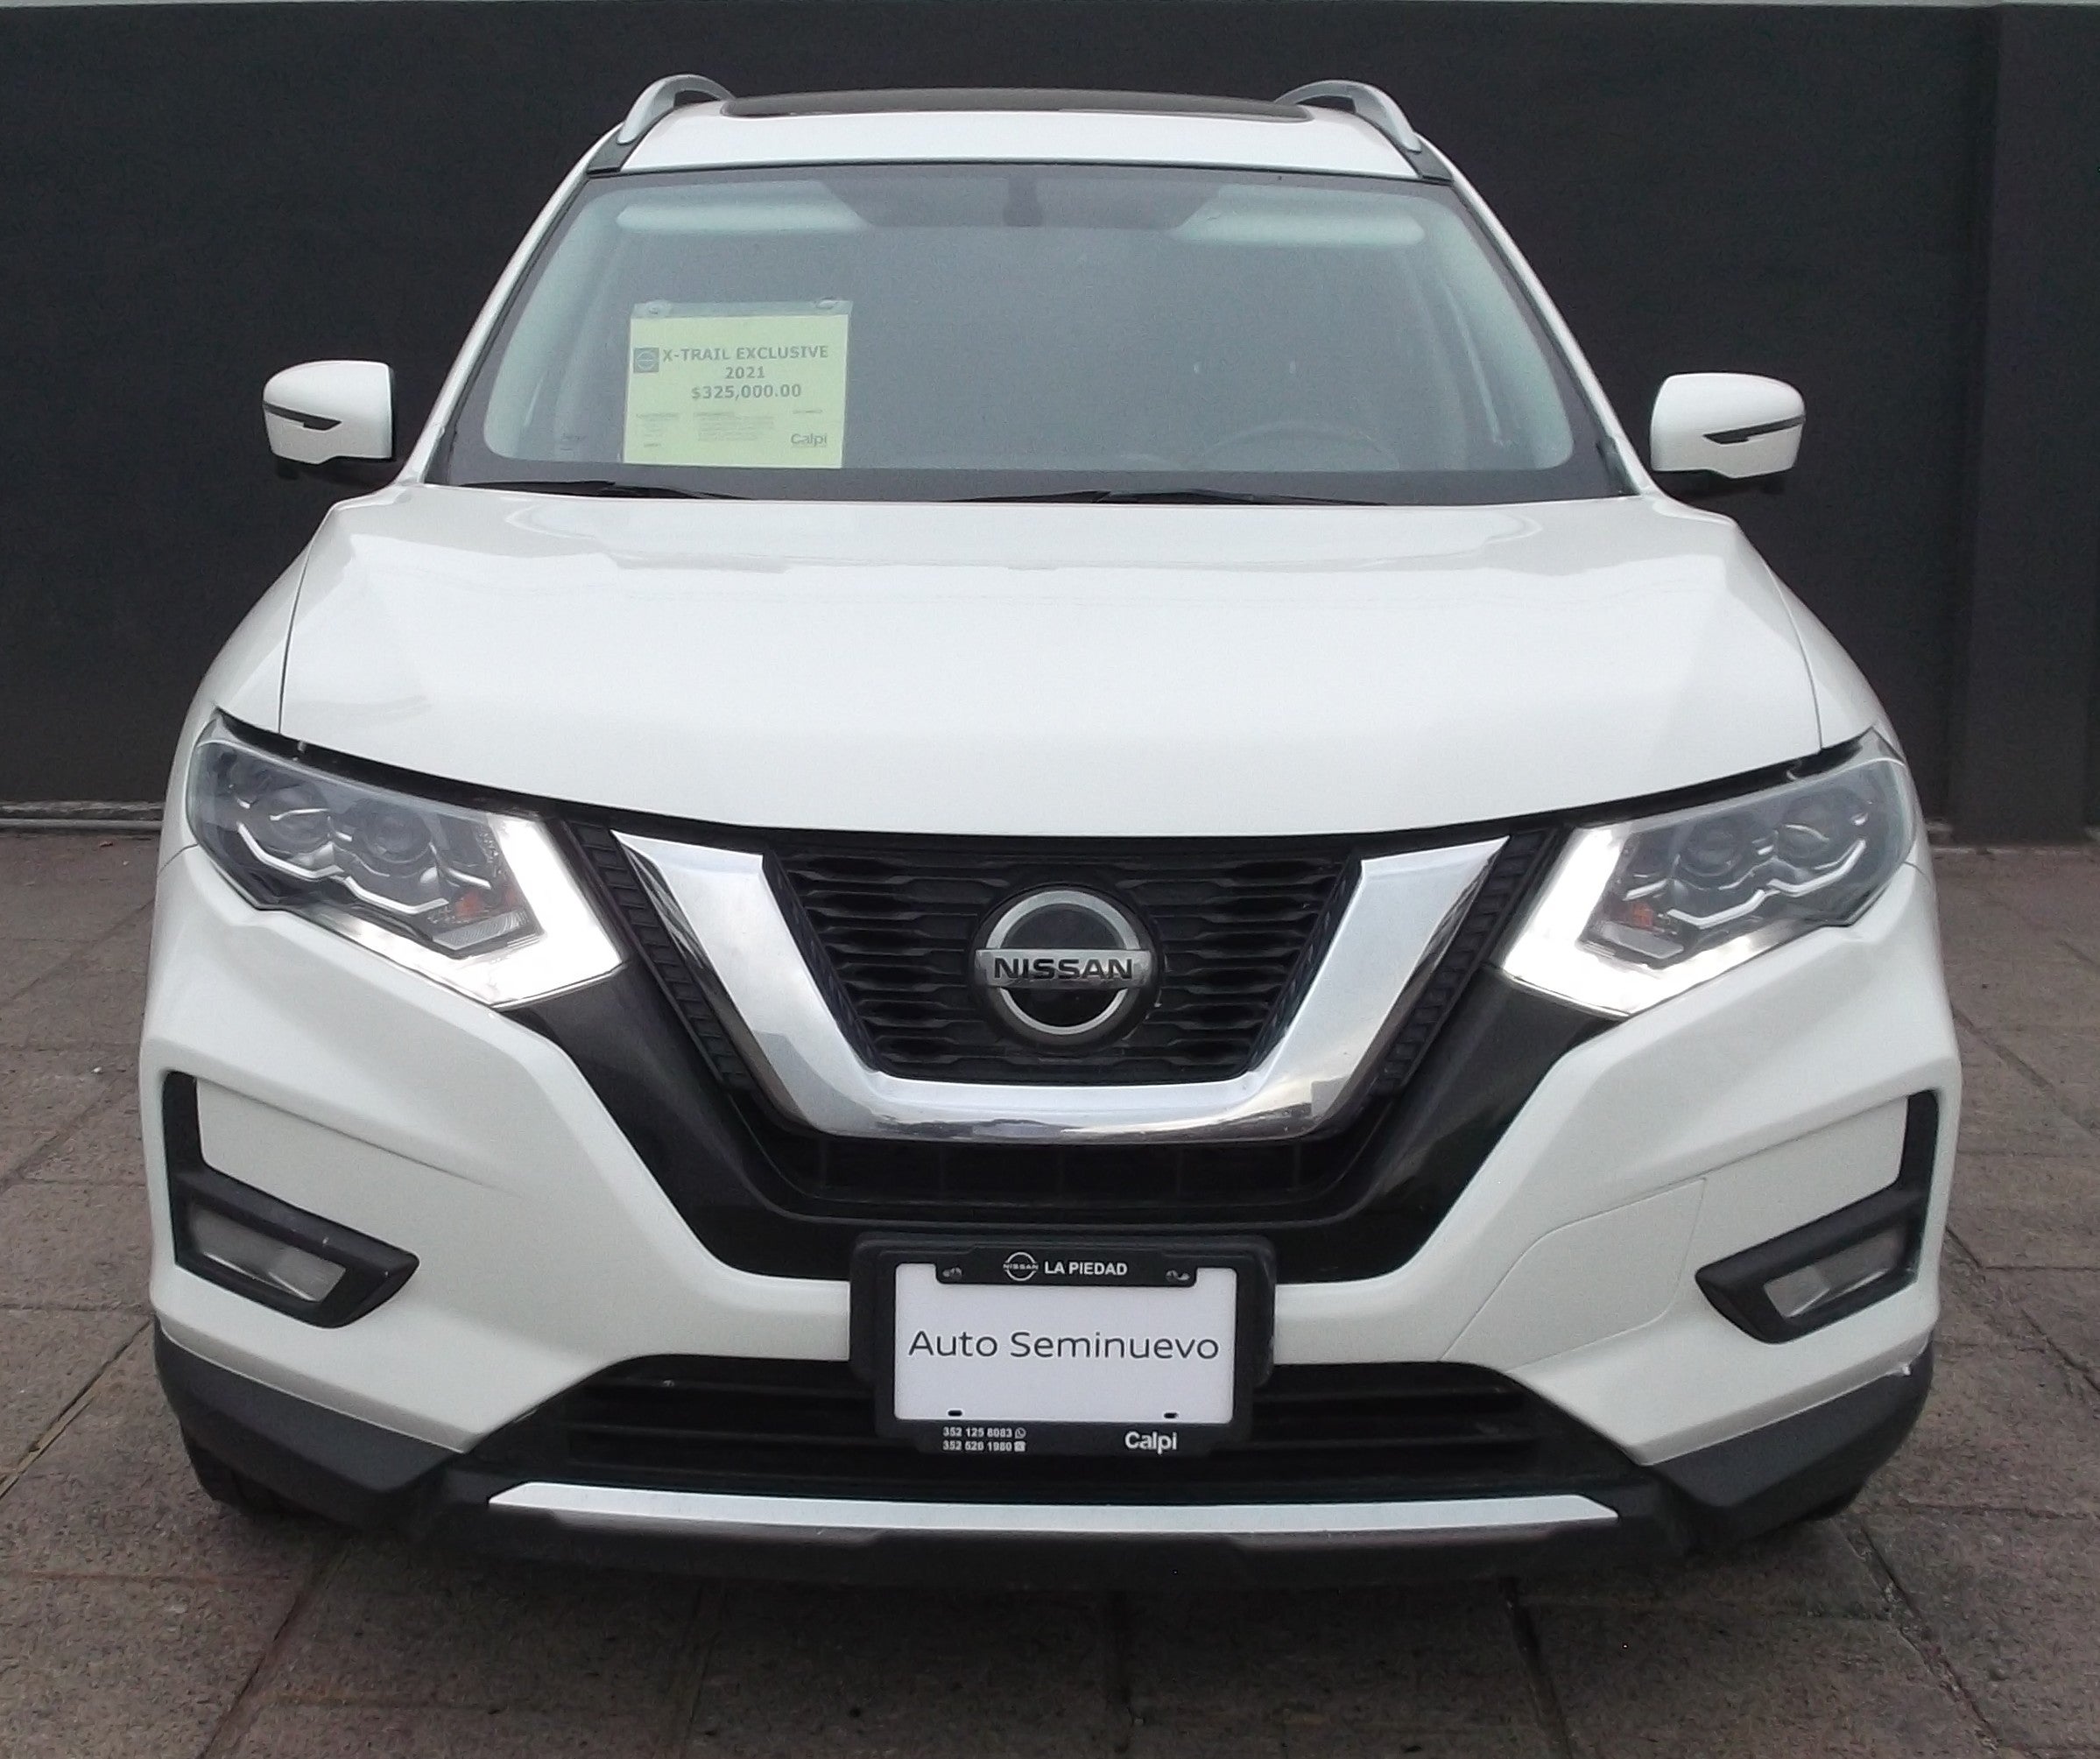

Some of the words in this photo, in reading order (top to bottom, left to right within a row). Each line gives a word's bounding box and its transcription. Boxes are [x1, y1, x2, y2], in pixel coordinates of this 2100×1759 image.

[663, 347, 730, 362] X-TRAIL
[736, 345, 828, 360] EXCLUSIVE
[724, 366, 765, 379] 2021
[691, 383, 801, 400] $325,000.00
[790, 433, 828, 447] Calpi
[994, 958, 1132, 980] NISSAN
[1045, 1261, 1065, 1274] LA
[1068, 1262, 1128, 1275] PIEDAD
[908, 1331, 997, 1357] Auto
[1010, 1331, 1219, 1360] Seminuevo
[1124, 1431, 1177, 1455] Calpi
